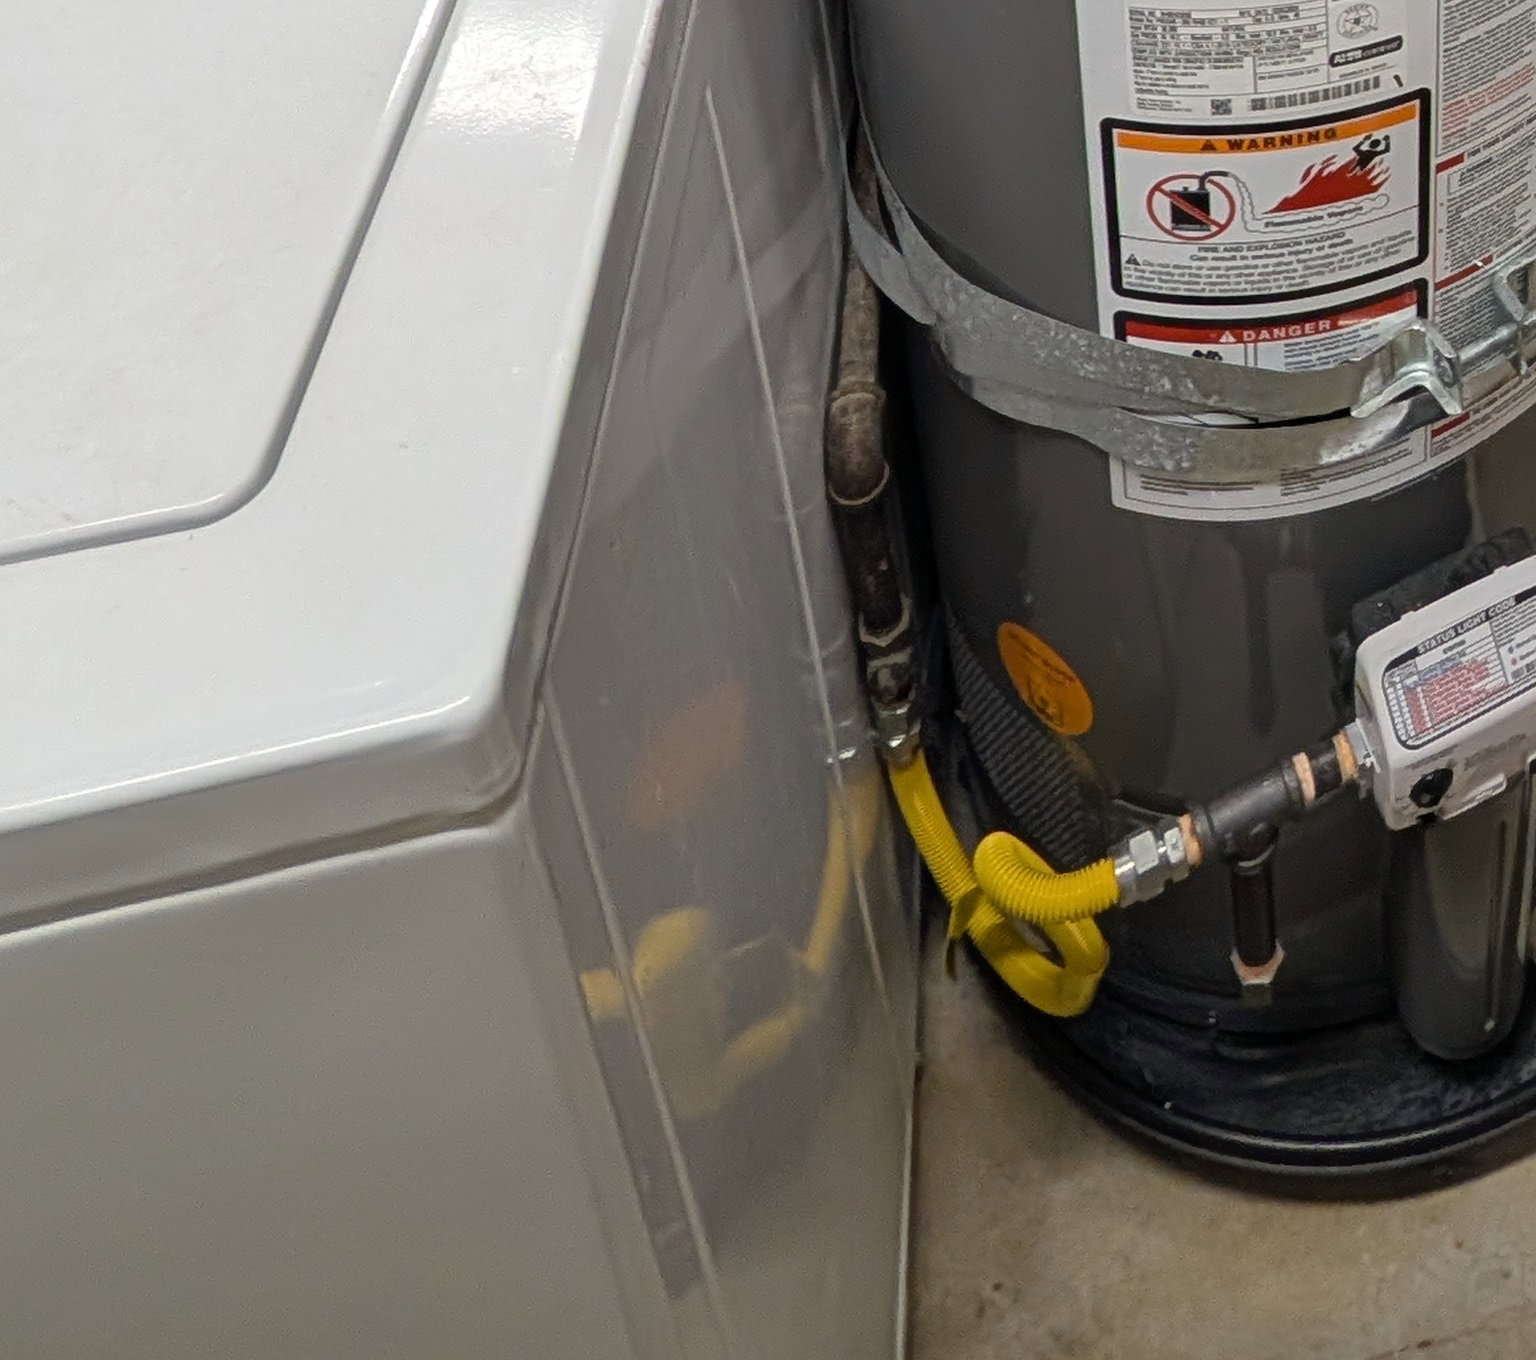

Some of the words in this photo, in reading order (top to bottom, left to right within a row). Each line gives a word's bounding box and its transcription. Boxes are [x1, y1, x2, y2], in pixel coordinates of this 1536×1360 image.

[1226, 128, 1338, 152] WARNING
[1242, 319, 1332, 342] DANGER
[1418, 626, 1456, 654] STATUS
[1457, 609, 1487, 634] LIGHT
